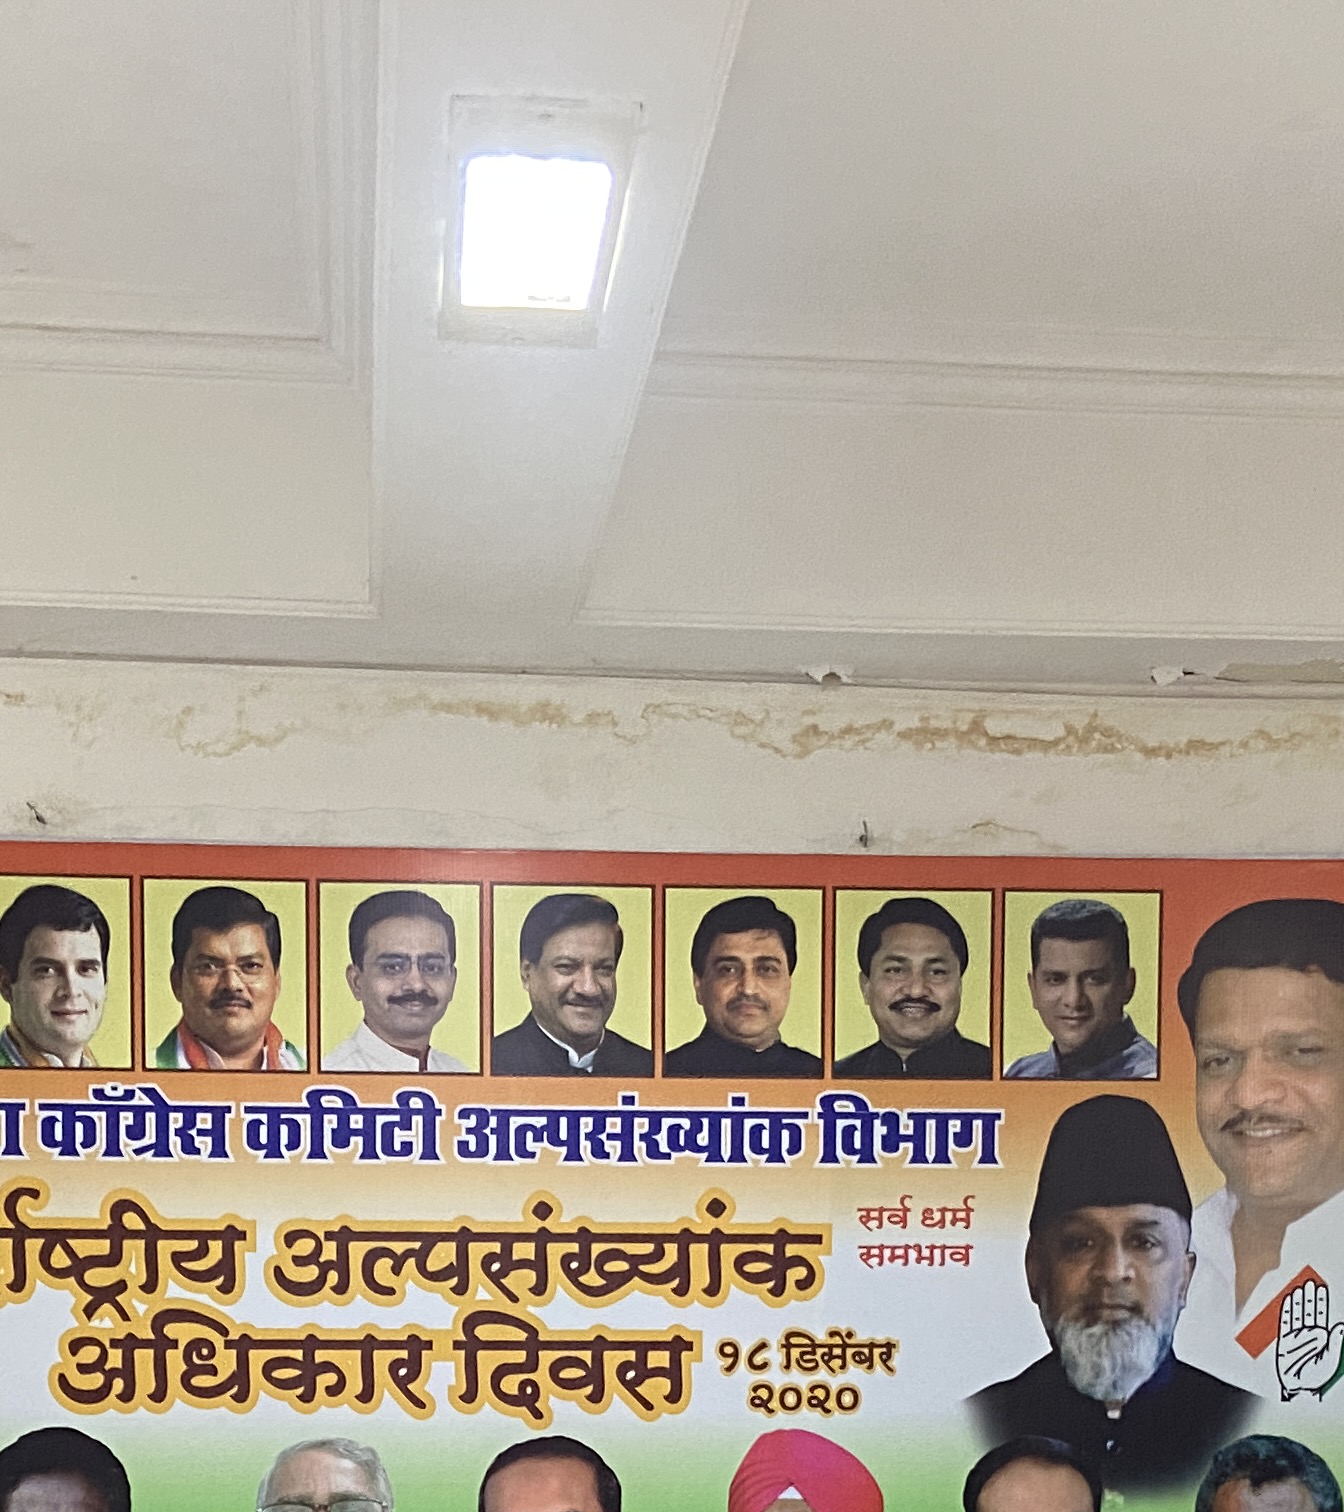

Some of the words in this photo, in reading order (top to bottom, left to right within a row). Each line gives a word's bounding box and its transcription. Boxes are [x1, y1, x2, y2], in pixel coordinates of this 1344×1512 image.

[243, 1086, 442, 1164] कमिटी
[456, 1092, 811, 1167] अल्पसंख्यांक
[814, 1090, 1003, 1168] विभाग
[857, 1196, 911, 1231] सर्व
[920, 1195, 975, 1230] धर्म
[270, 1196, 826, 1305] अल्पसंख्यांक
[857, 1241, 973, 1269] समभाव
[56, 1306, 433, 1411] अधिकार
[454, 1307, 695, 1422] दिवस
[716, 1338, 771, 1376] १८
[779, 1329, 897, 1376] डिसेंबर
[748, 1381, 862, 1417] २०२०
